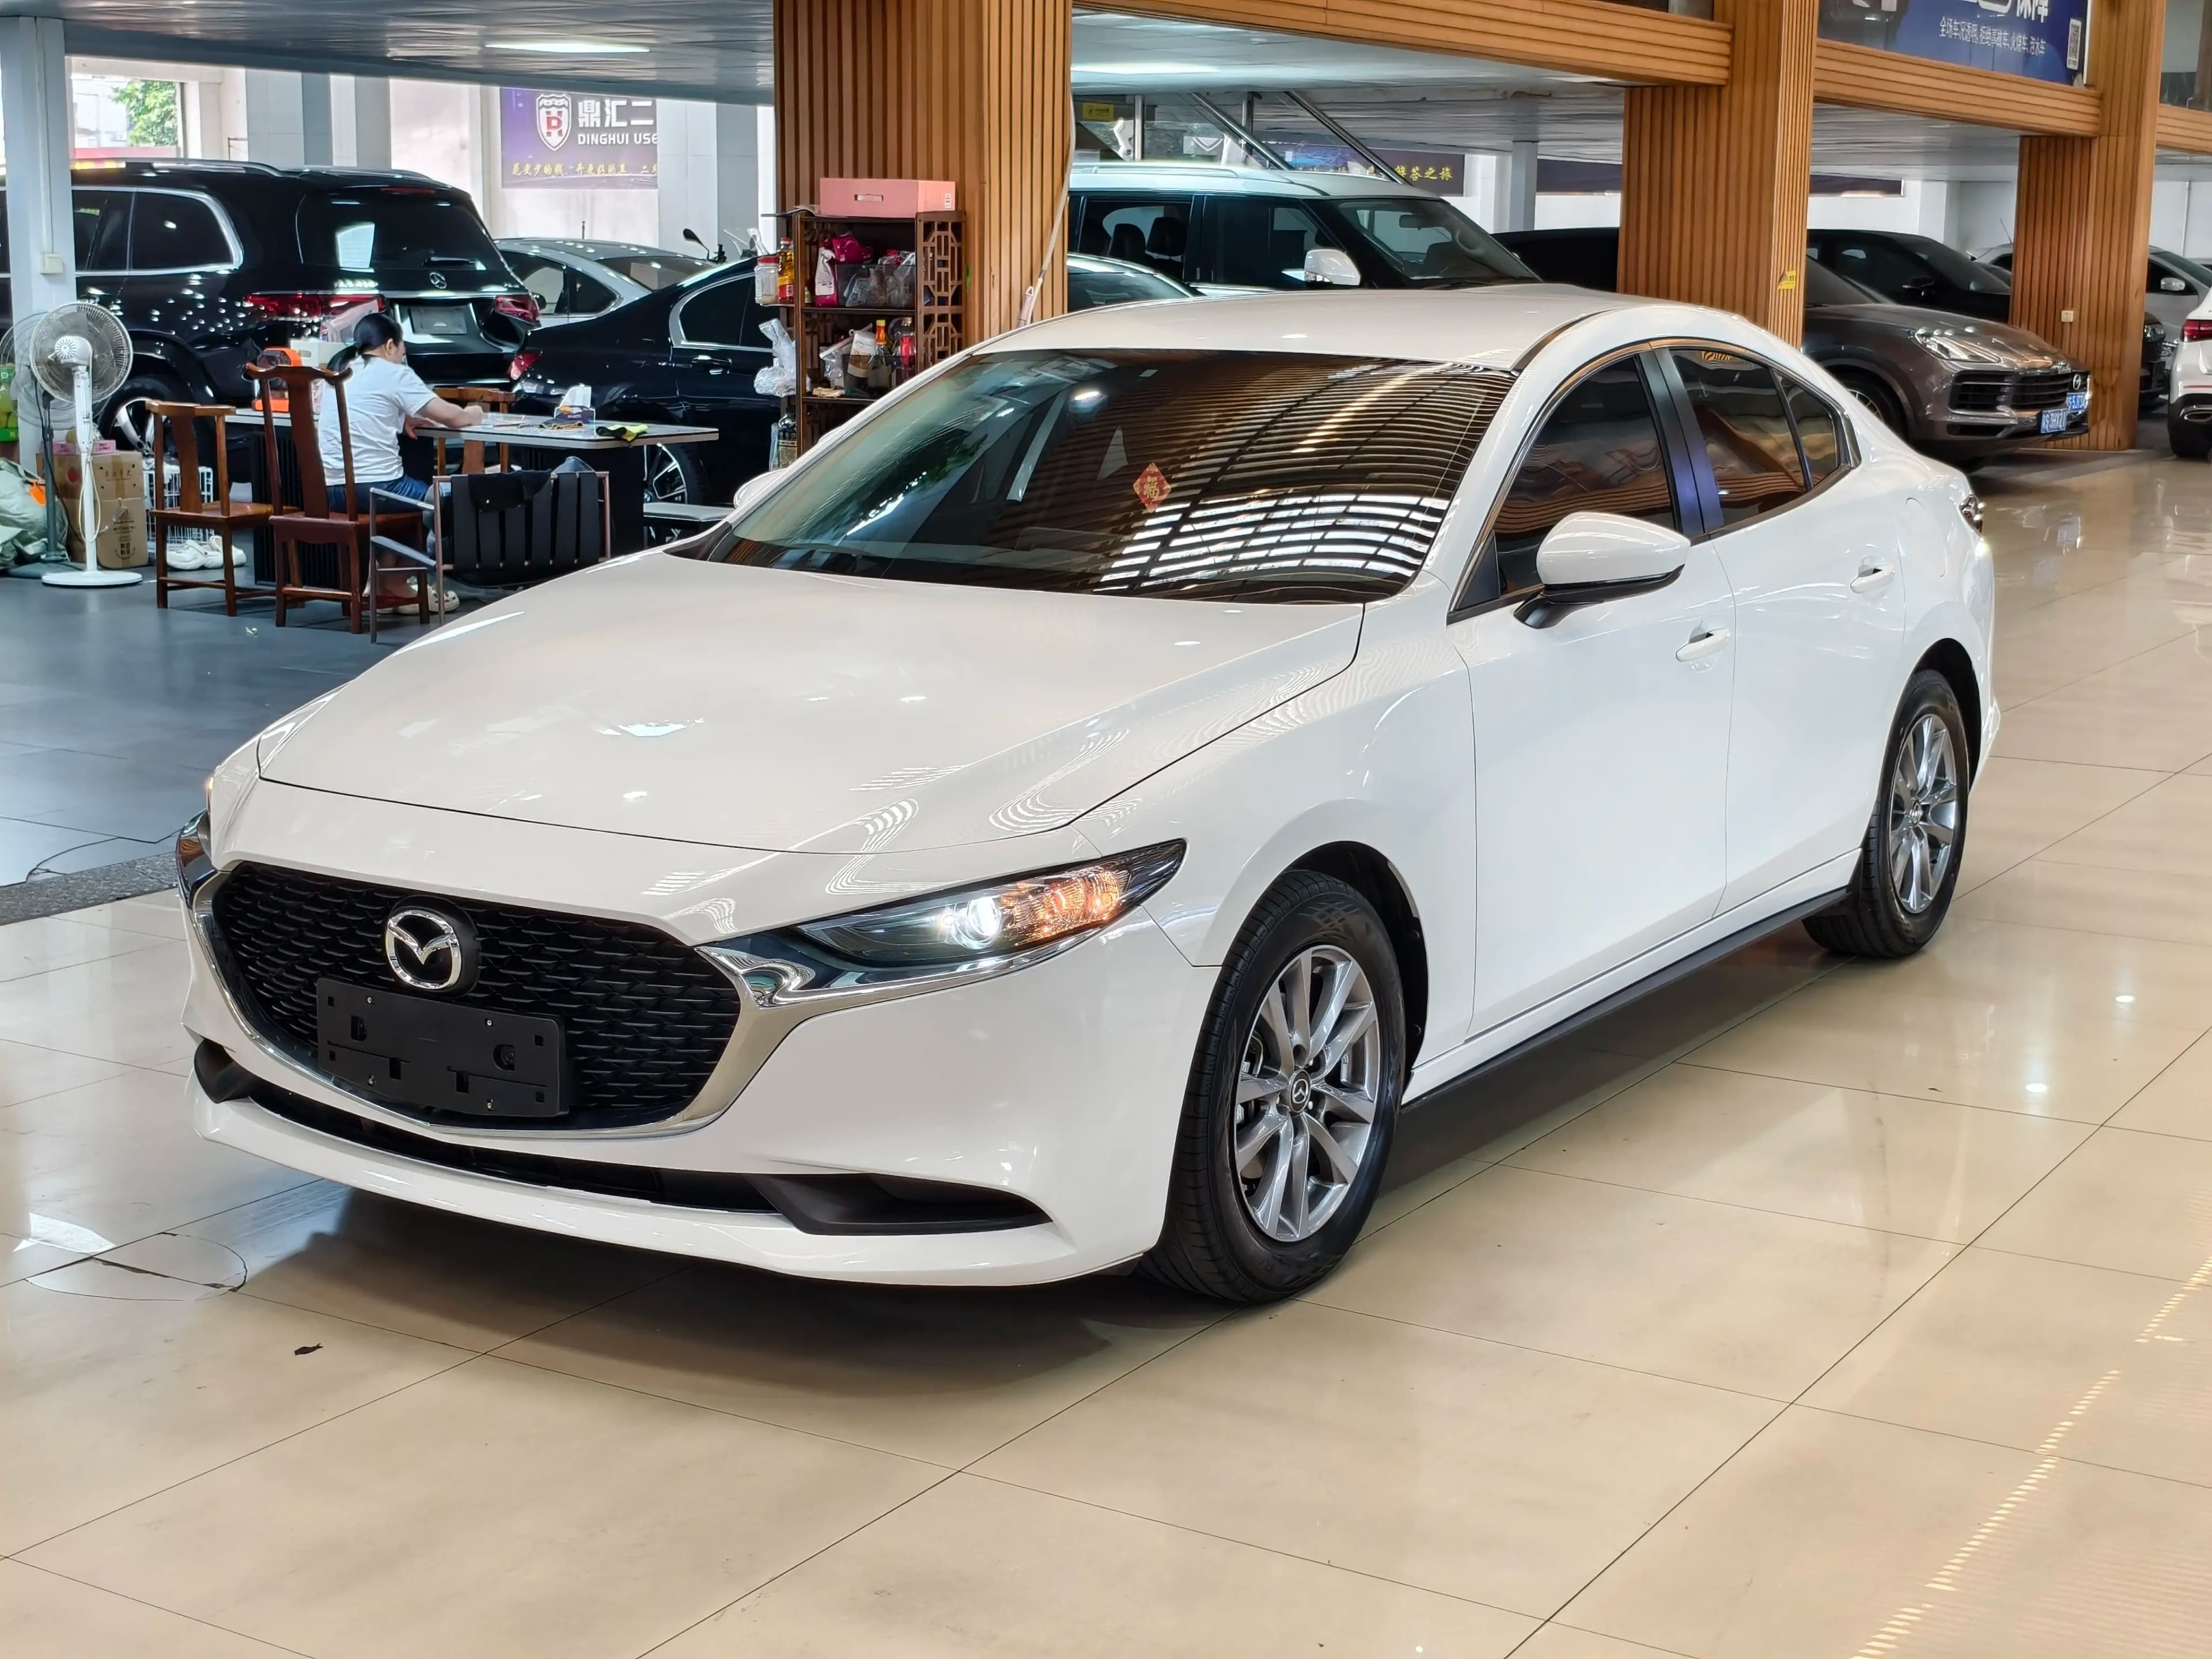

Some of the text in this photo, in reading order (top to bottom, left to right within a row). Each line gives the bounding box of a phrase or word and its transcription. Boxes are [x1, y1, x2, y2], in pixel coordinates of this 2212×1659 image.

[578, 99, 654, 127] 鼎汇二
[578, 133, 629, 145] DINGHUI
